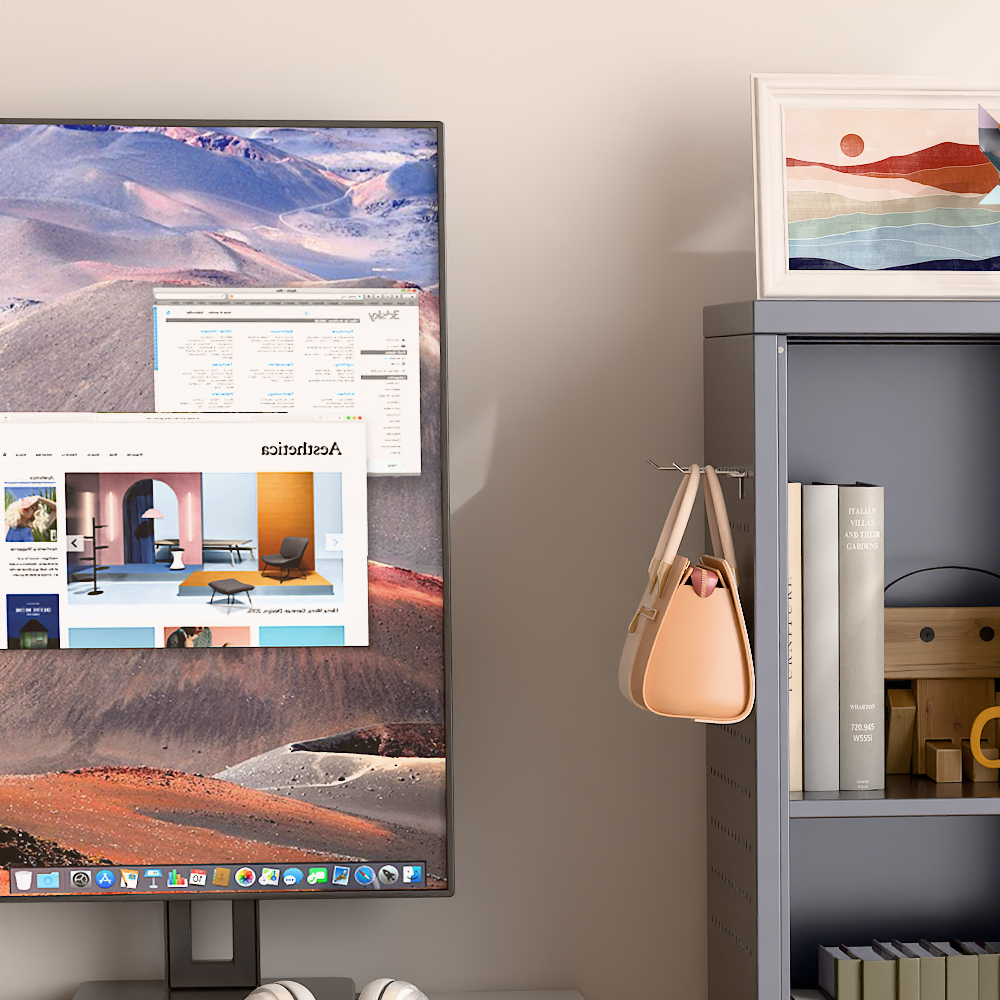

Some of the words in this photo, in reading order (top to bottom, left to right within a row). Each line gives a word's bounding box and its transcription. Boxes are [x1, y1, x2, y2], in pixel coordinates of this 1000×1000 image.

[848, 507, 877, 515] ITALIAN
[850, 519, 875, 527] VILLAS
[843, 531, 859, 539] AND
[846, 542, 879, 550] GARDENS
[850, 723, 875, 731] 720.945
